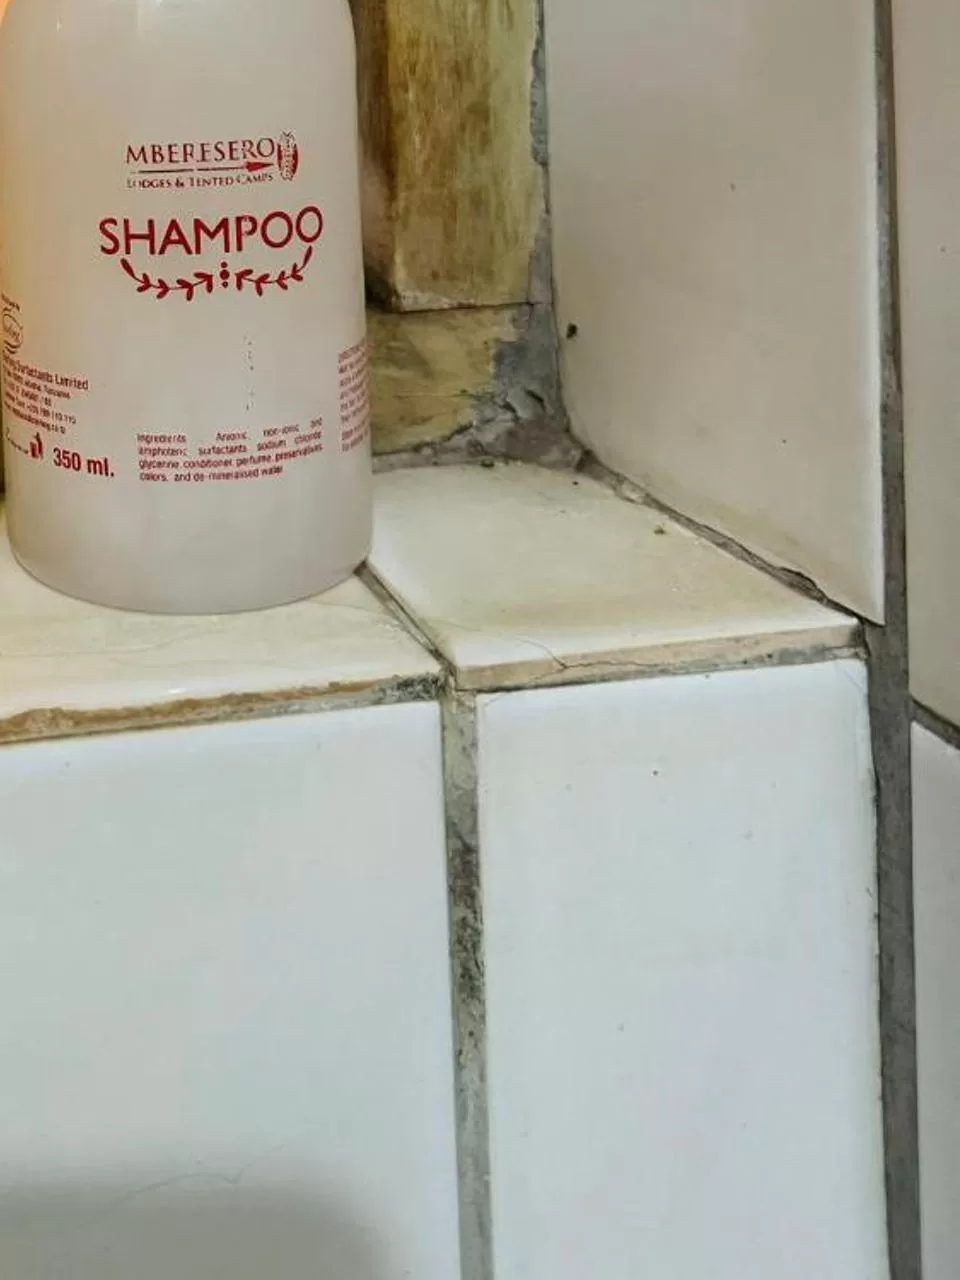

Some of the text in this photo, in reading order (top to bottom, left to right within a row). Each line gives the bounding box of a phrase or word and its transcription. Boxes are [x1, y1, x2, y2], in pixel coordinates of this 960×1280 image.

[126, 137, 276, 164] MBERESERO
[127, 178, 171, 188] LODGES
[190, 175, 234, 187] TENTED
[238, 173, 274, 184] CAMPS
[98, 205, 325, 256] SHAMPOO
[55, 373, 89, 391] Limited
[53, 447, 115, 478] 350 ml.
[174, 472, 191, 483] and
